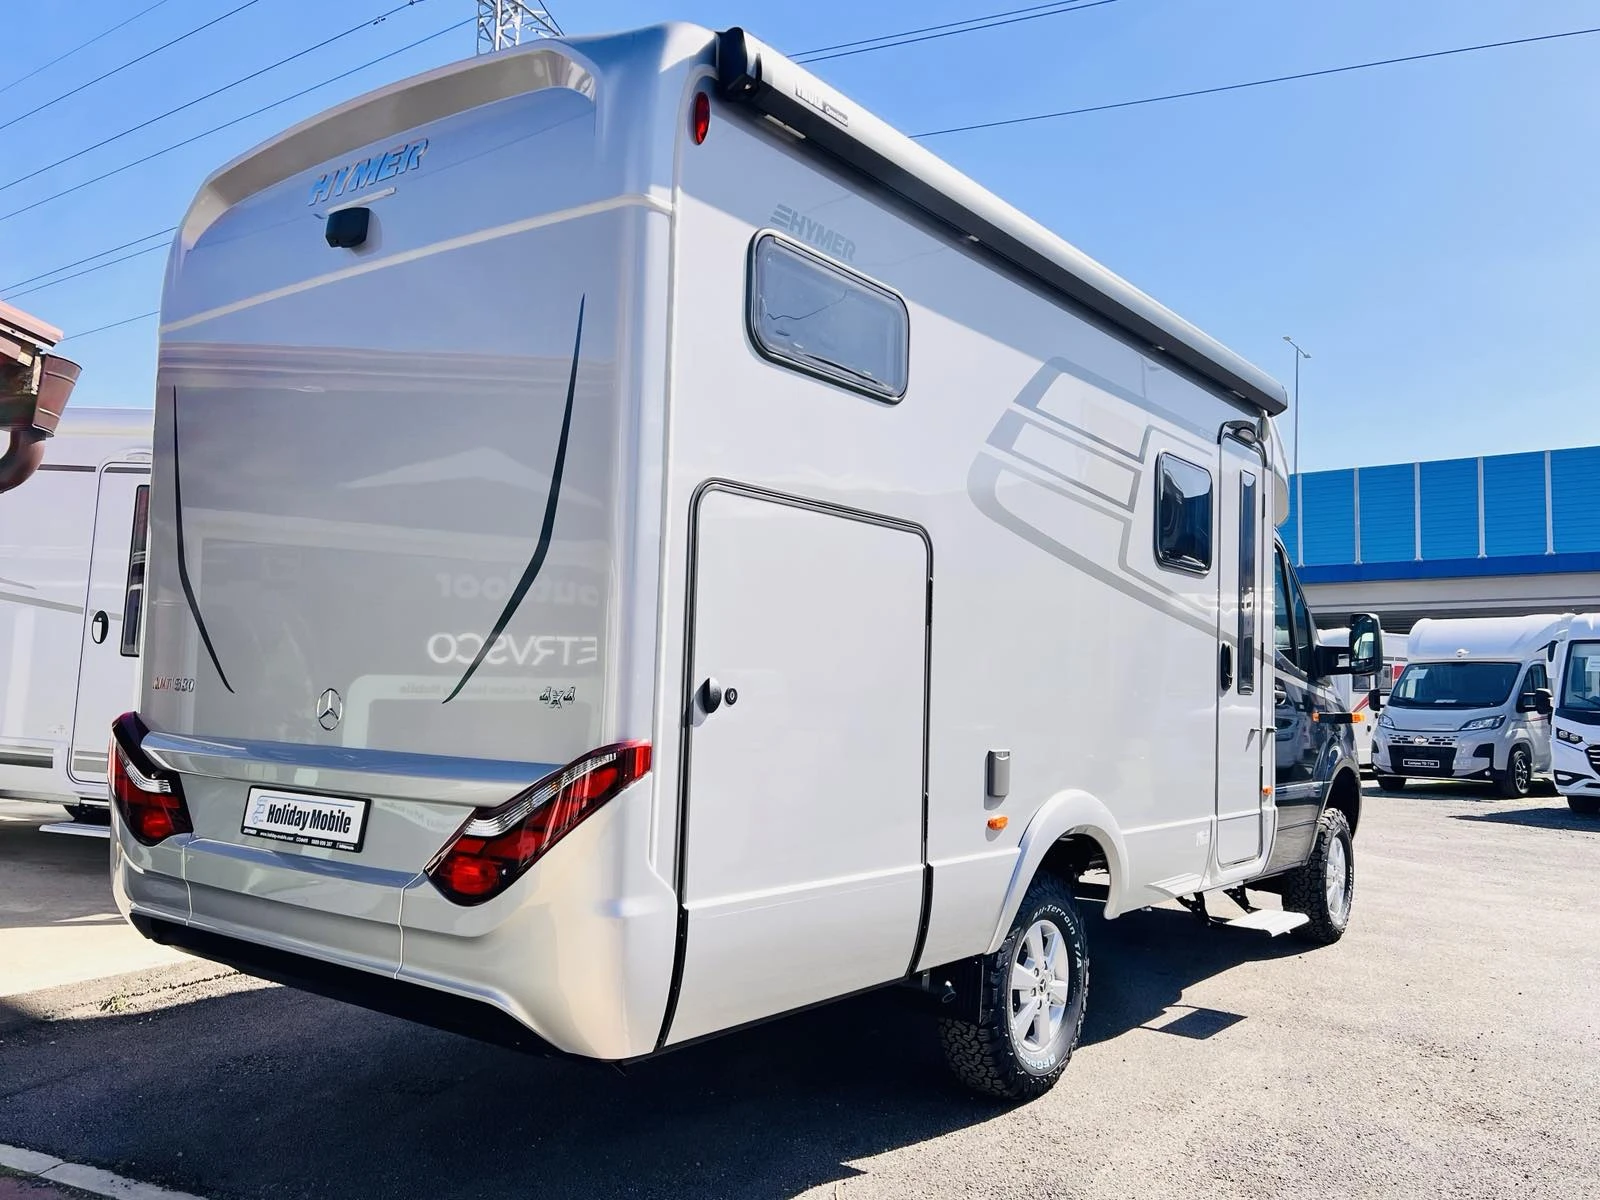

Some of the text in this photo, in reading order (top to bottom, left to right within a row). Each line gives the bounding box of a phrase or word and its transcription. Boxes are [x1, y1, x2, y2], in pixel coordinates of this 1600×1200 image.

[307, 137, 429, 206] HYMER
[789, 209, 856, 261] HYMER
[266, 803, 311, 831] Holiday
[309, 809, 352, 834] Mobile
[1032, 904, 1082, 968] All-Terrain T/A
